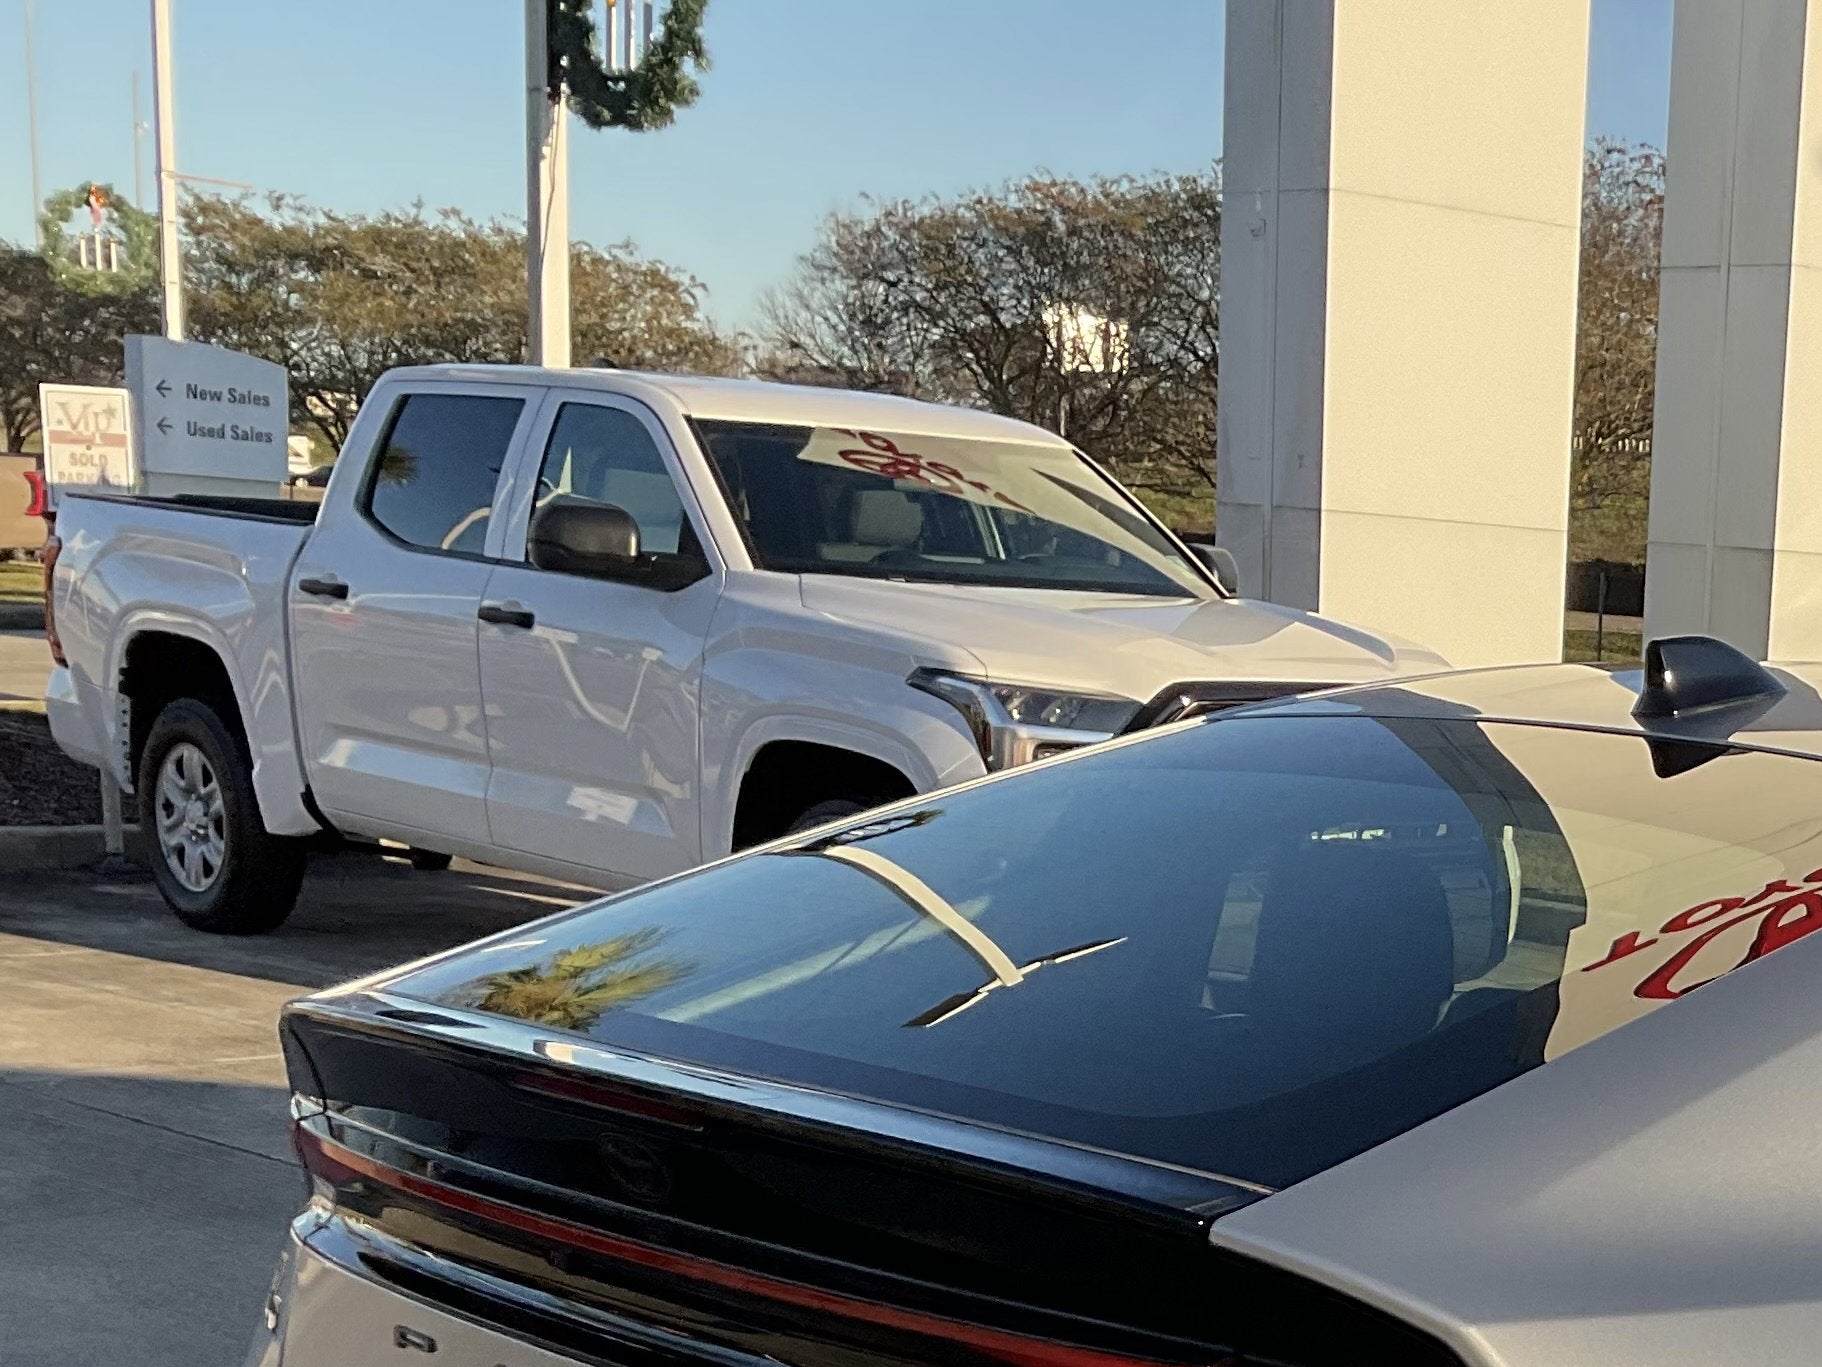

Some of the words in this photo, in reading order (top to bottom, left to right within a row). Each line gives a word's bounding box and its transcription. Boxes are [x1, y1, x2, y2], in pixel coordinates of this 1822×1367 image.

[186, 383, 222, 402] New
[228, 387, 270, 407] Sales
[186, 421, 226, 440] Used
[230, 425, 273, 443] Sales
[69, 452, 108, 467] SOLD
